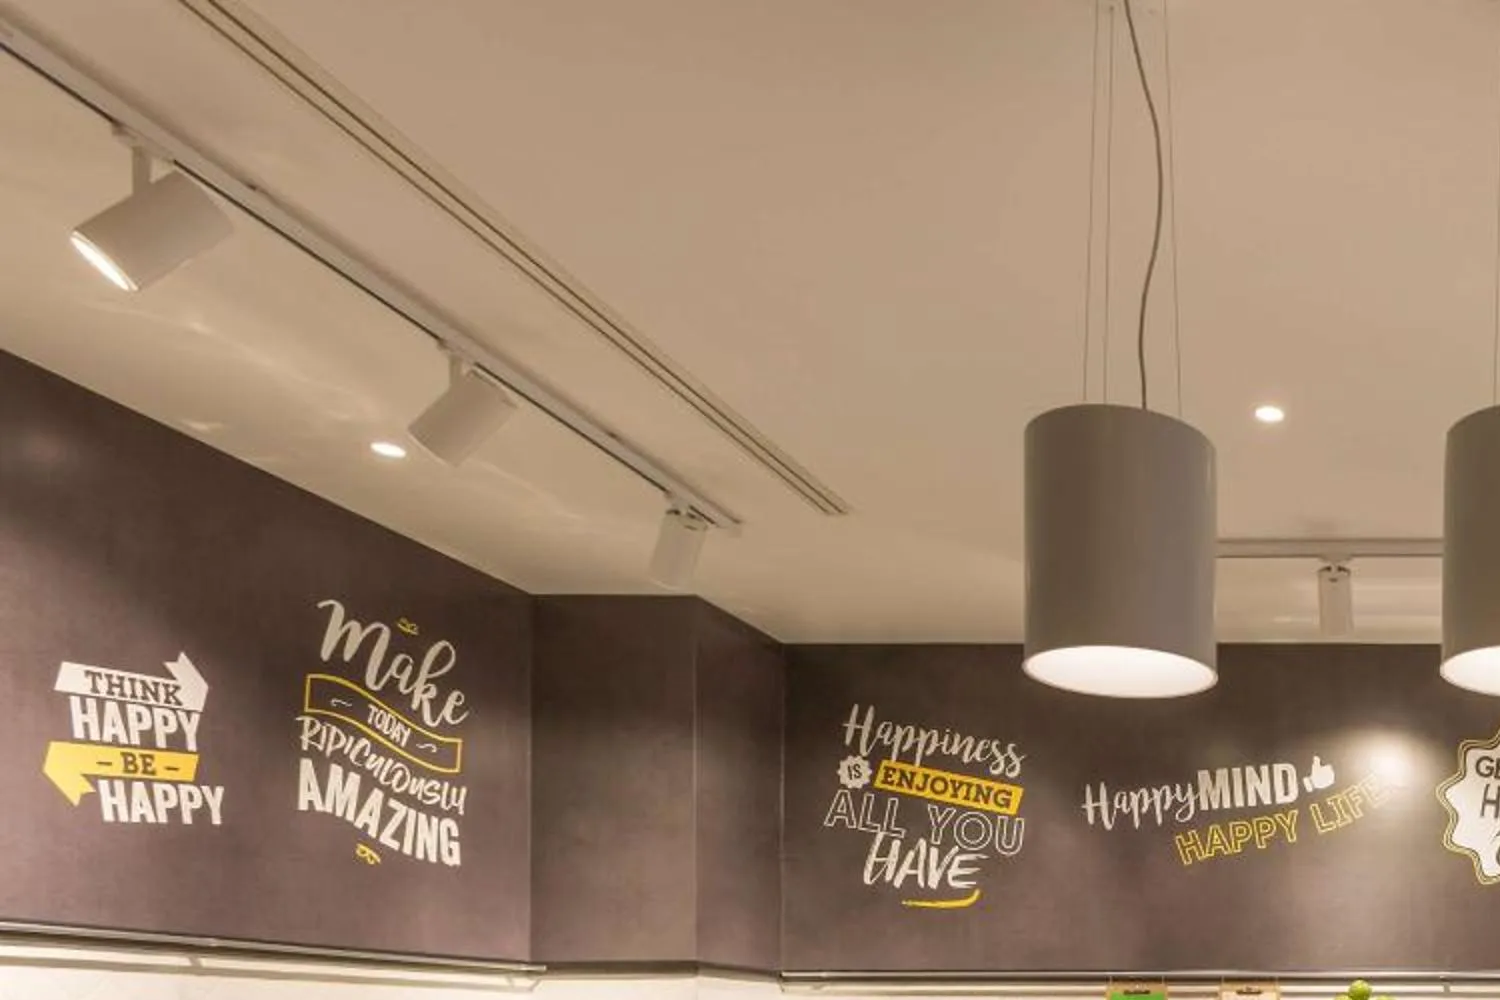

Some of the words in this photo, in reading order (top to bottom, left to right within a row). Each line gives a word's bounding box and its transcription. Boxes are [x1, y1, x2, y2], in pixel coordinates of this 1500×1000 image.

[84, 670, 182, 706] THINK
[318, 600, 469, 727] Make
[69, 696, 200, 752] HAPPY
[367, 703, 411, 747] TODAY
[843, 703, 1026, 777] Happiness
[121, 752, 157, 776] BE
[847, 762, 862, 780] IS
[881, 768, 1014, 809] ENJOYING
[1198, 763, 1298, 811] MIND
[99, 780, 224, 825] HAPPY
[298, 758, 461, 867] AMAZING
[824, 789, 904, 837] ALL
[927, 804, 1025, 854] YOU
[1176, 810, 1299, 865] HAPPY
[1310, 772, 1389, 833] LIFE
[863, 832, 989, 888] HAVE
